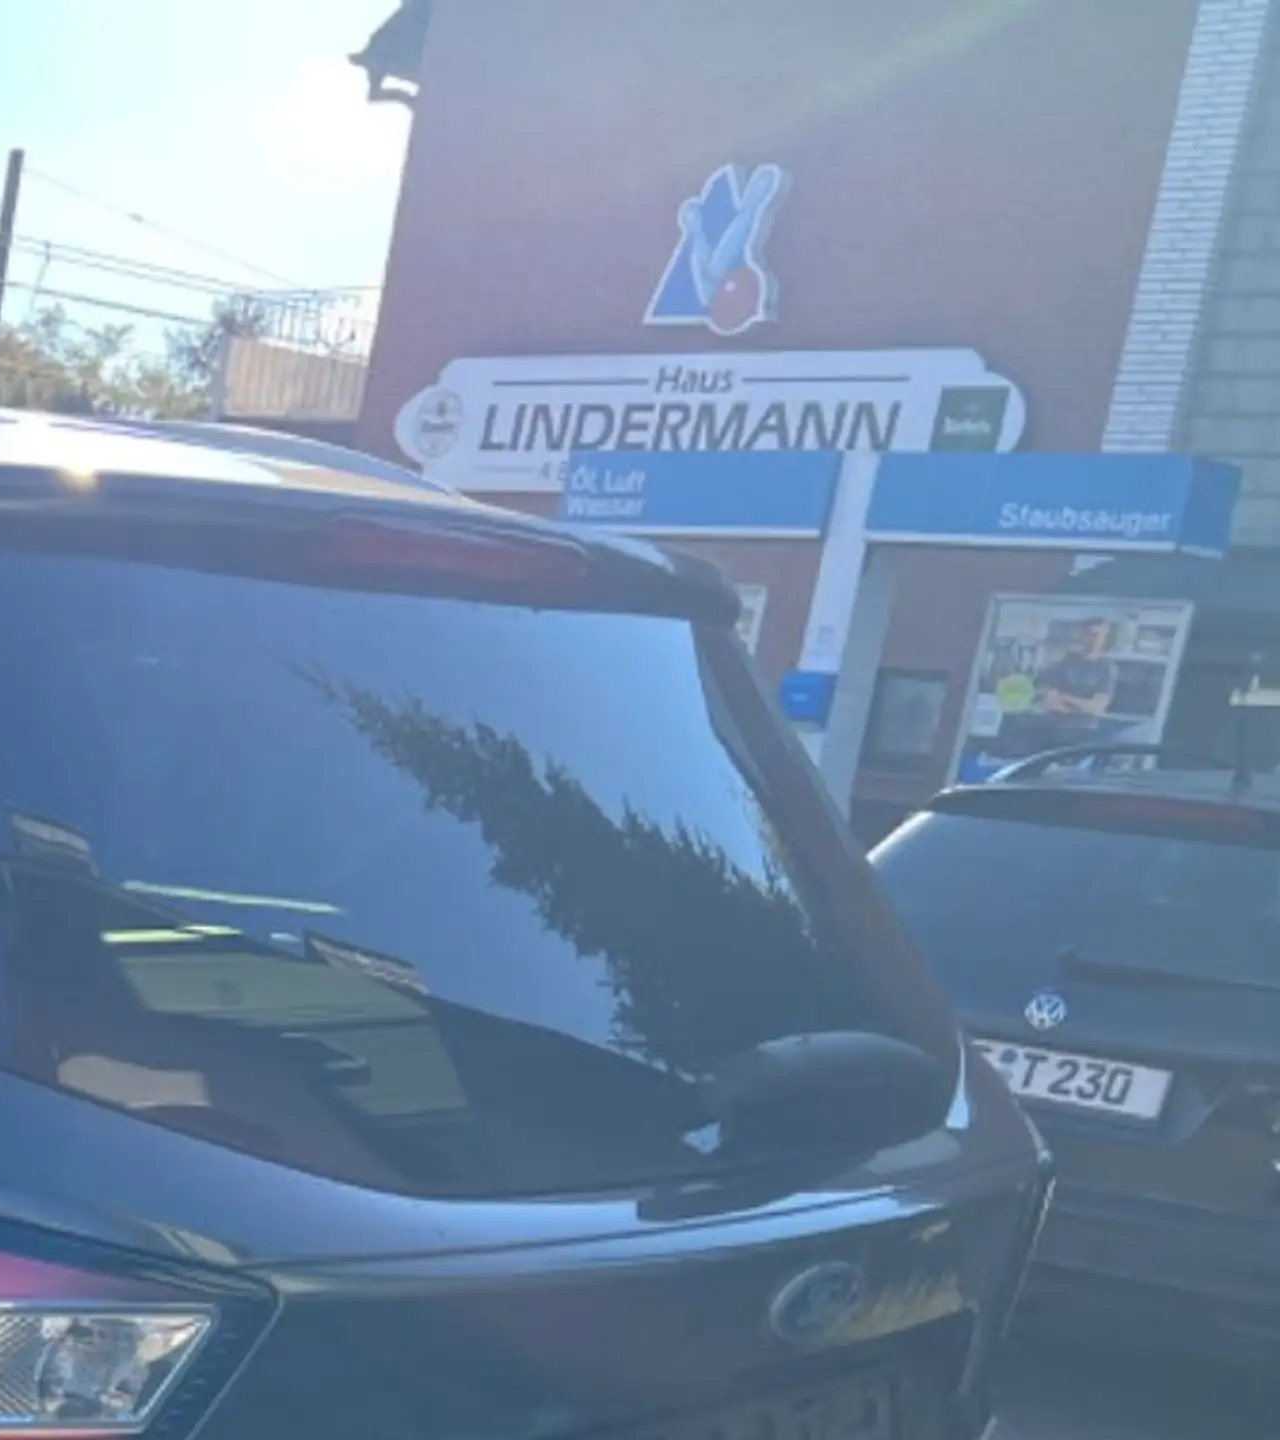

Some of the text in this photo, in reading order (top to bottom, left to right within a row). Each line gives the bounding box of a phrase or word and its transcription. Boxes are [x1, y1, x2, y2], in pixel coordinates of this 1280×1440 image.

[654, 364, 735, 395] Haus
[478, 400, 903, 452] LINDERMANN
[603, 469, 646, 493] Luft
[998, 501, 1173, 538] Staubsauger
[1047, 1058, 1134, 1106] 230
